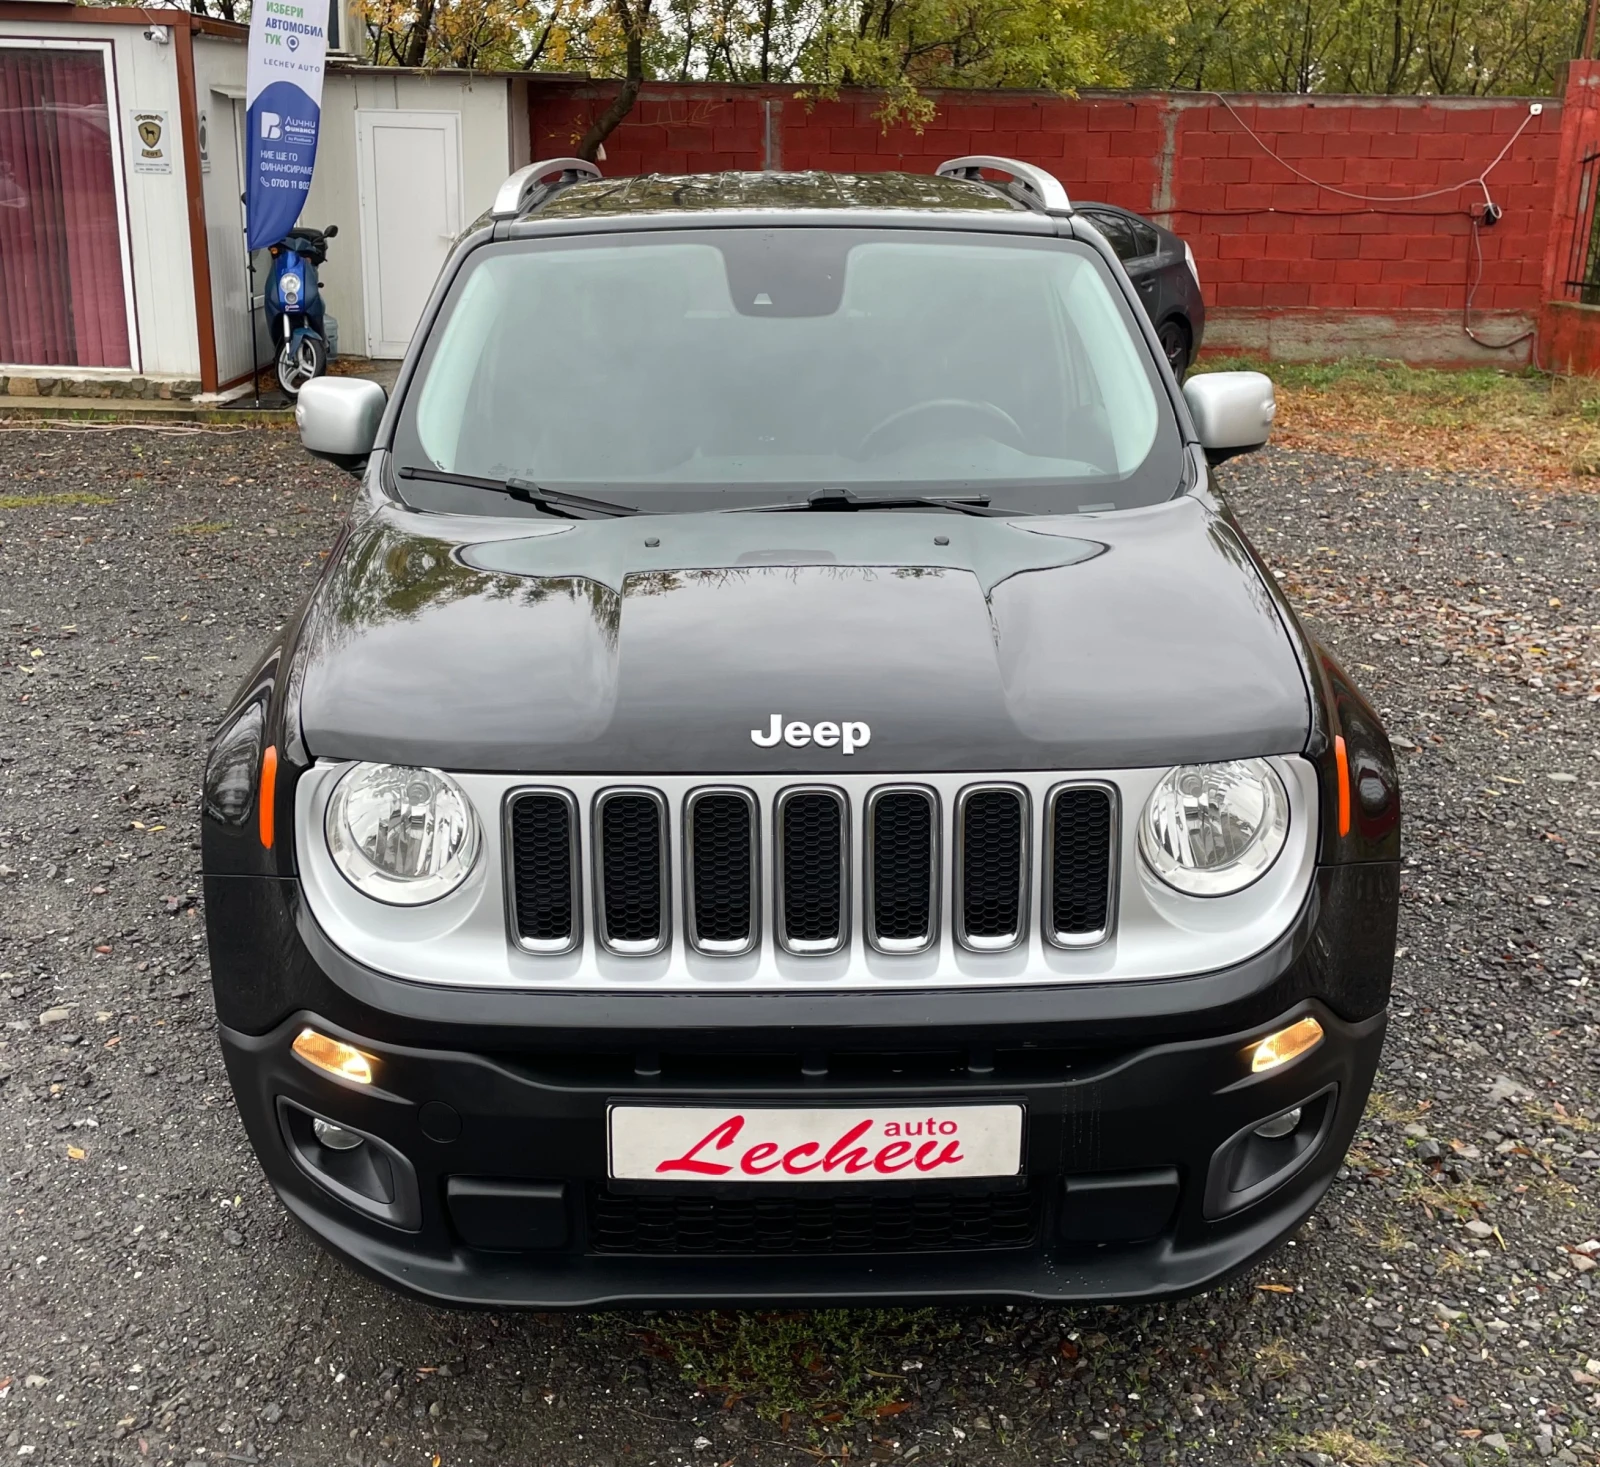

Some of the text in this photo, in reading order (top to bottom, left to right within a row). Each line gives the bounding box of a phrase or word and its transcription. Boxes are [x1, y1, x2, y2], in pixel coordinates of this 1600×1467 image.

[266, 1, 304, 18] ИЗБЕРИ
[265, 17, 323, 38] АВТОМОБИЛ
[265, 33, 281, 45] ТУК
[264, 58, 320, 73] LECHEV AUTO
[260, 149, 275, 160] НИЕ
[288, 152, 298, 162] ГО
[260, 161, 313, 175] ФИНАНСИРАМЕ
[271, 178, 290, 188] 0700
[291, 180, 297, 189] 11
[750, 713, 871, 755] Jeep
[884, 1117, 958, 1137] auto
[655, 1114, 964, 1175] Lechev
